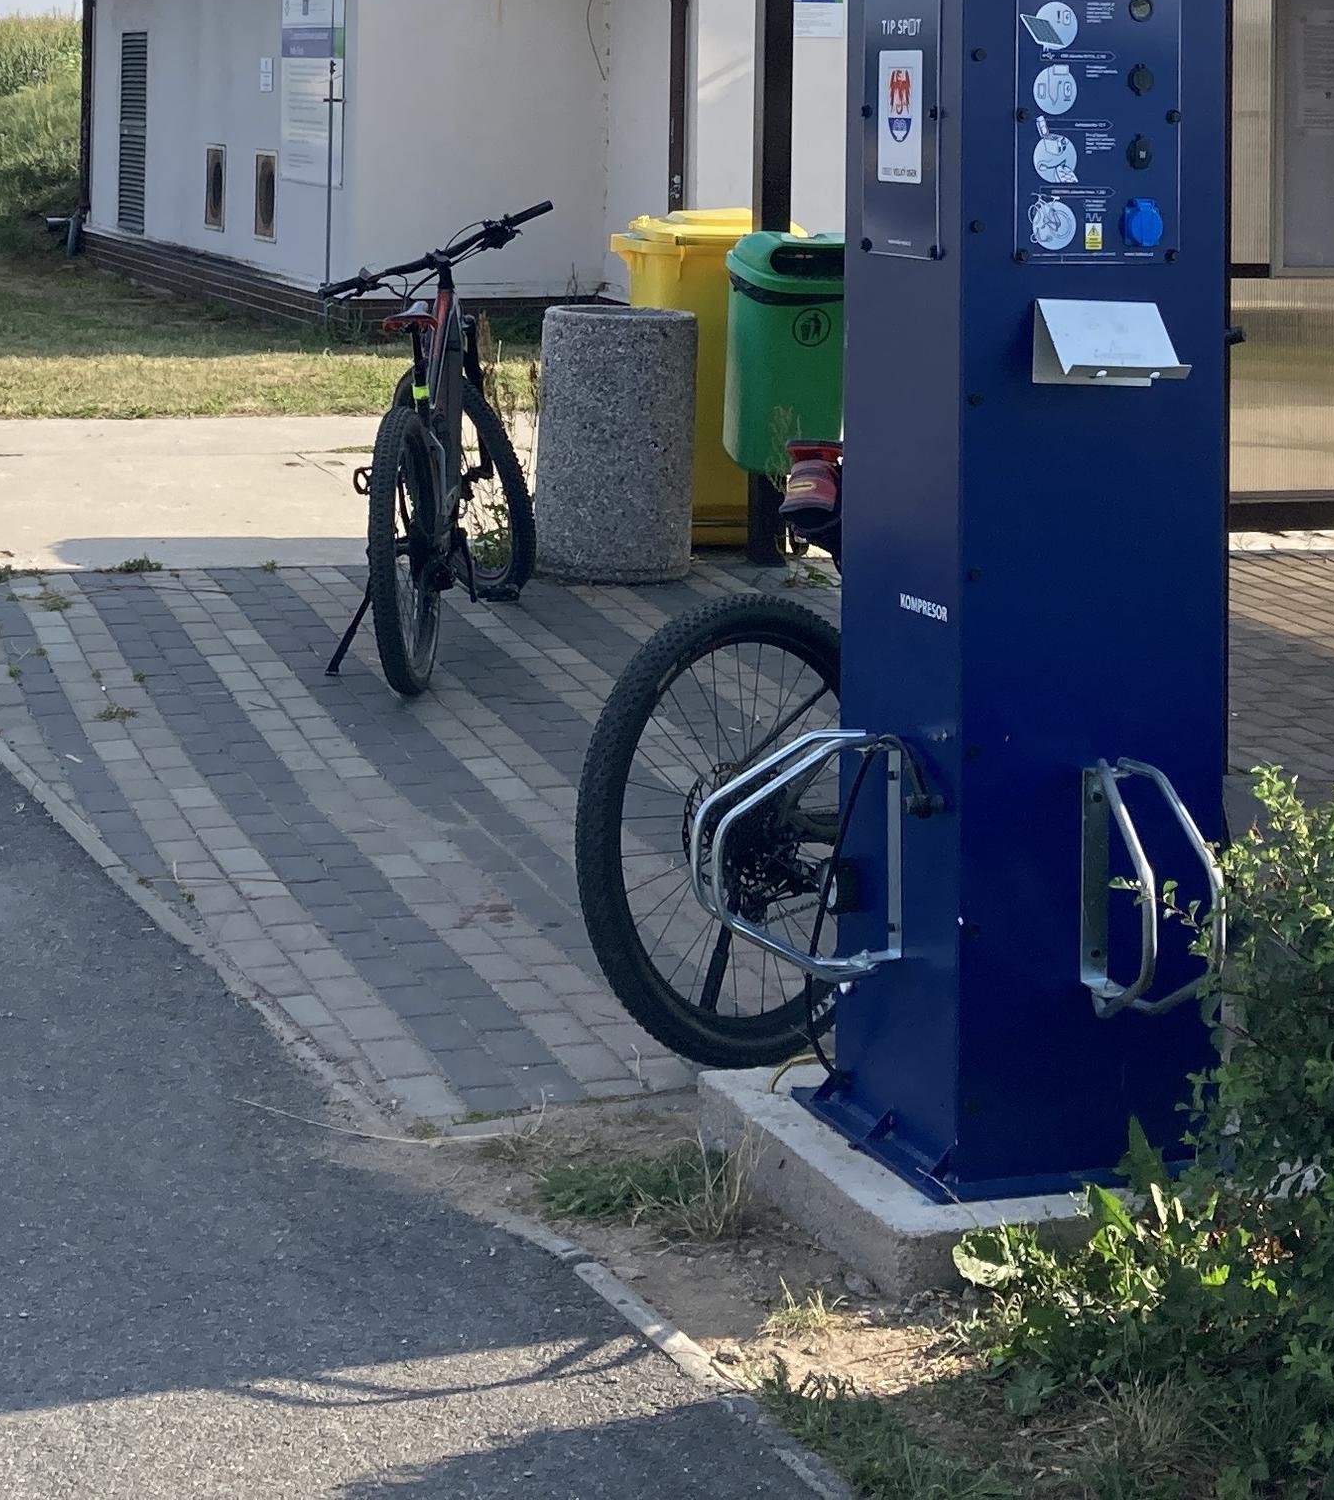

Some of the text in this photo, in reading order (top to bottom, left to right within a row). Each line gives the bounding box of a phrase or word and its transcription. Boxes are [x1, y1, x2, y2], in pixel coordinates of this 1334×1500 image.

[881, 18, 922, 37] TIP SPOT
[899, 592, 948, 623] KOMPRESOR
